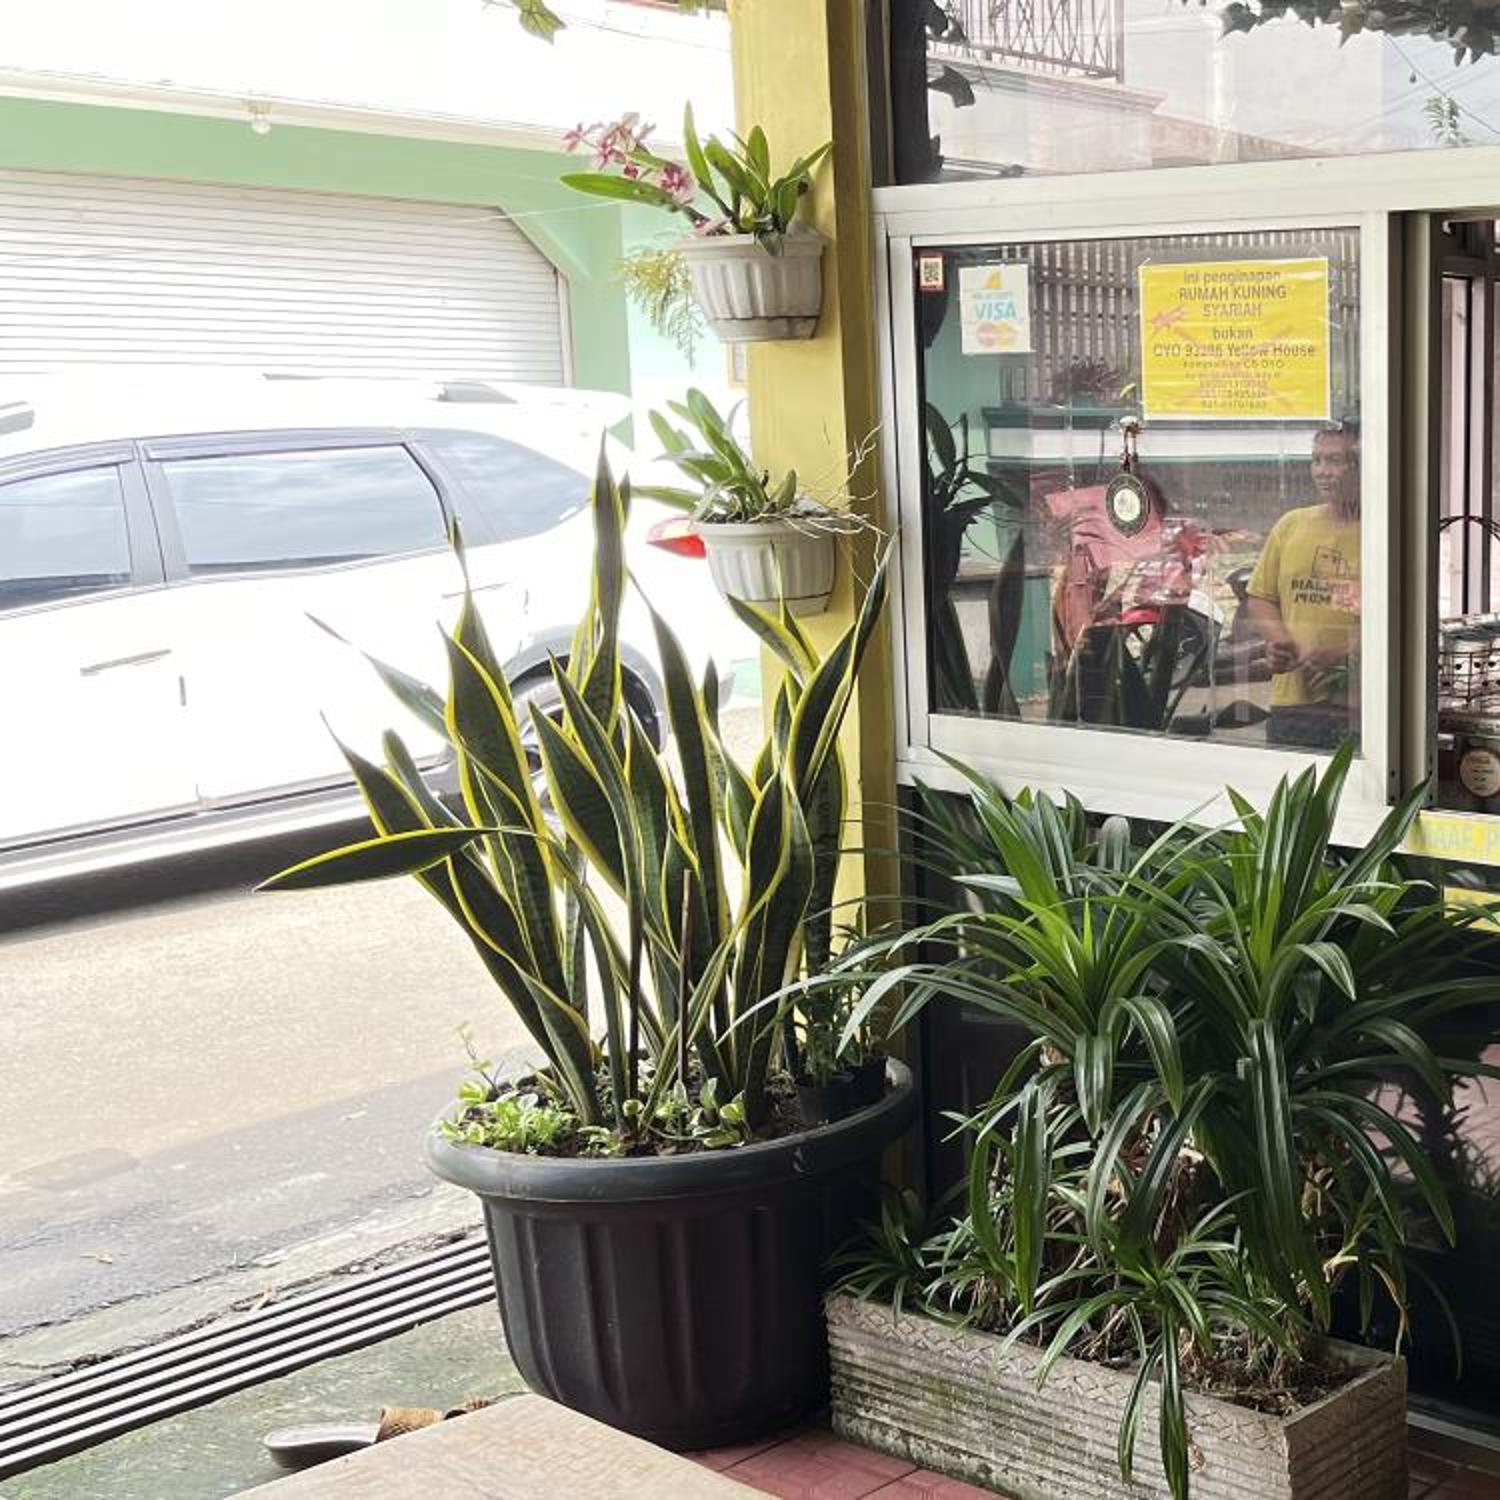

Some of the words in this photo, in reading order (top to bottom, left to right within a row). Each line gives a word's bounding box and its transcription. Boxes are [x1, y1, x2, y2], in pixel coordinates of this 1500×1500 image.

[1178, 285, 1229, 302] RUMAH
[1233, 284, 1288, 300] KUNING
[976, 301, 1017, 320] VISA
[1202, 303, 1262, 318] SYARIAH
[1213, 325, 1253, 341] bukan
[1273, 340, 1316, 358] House
